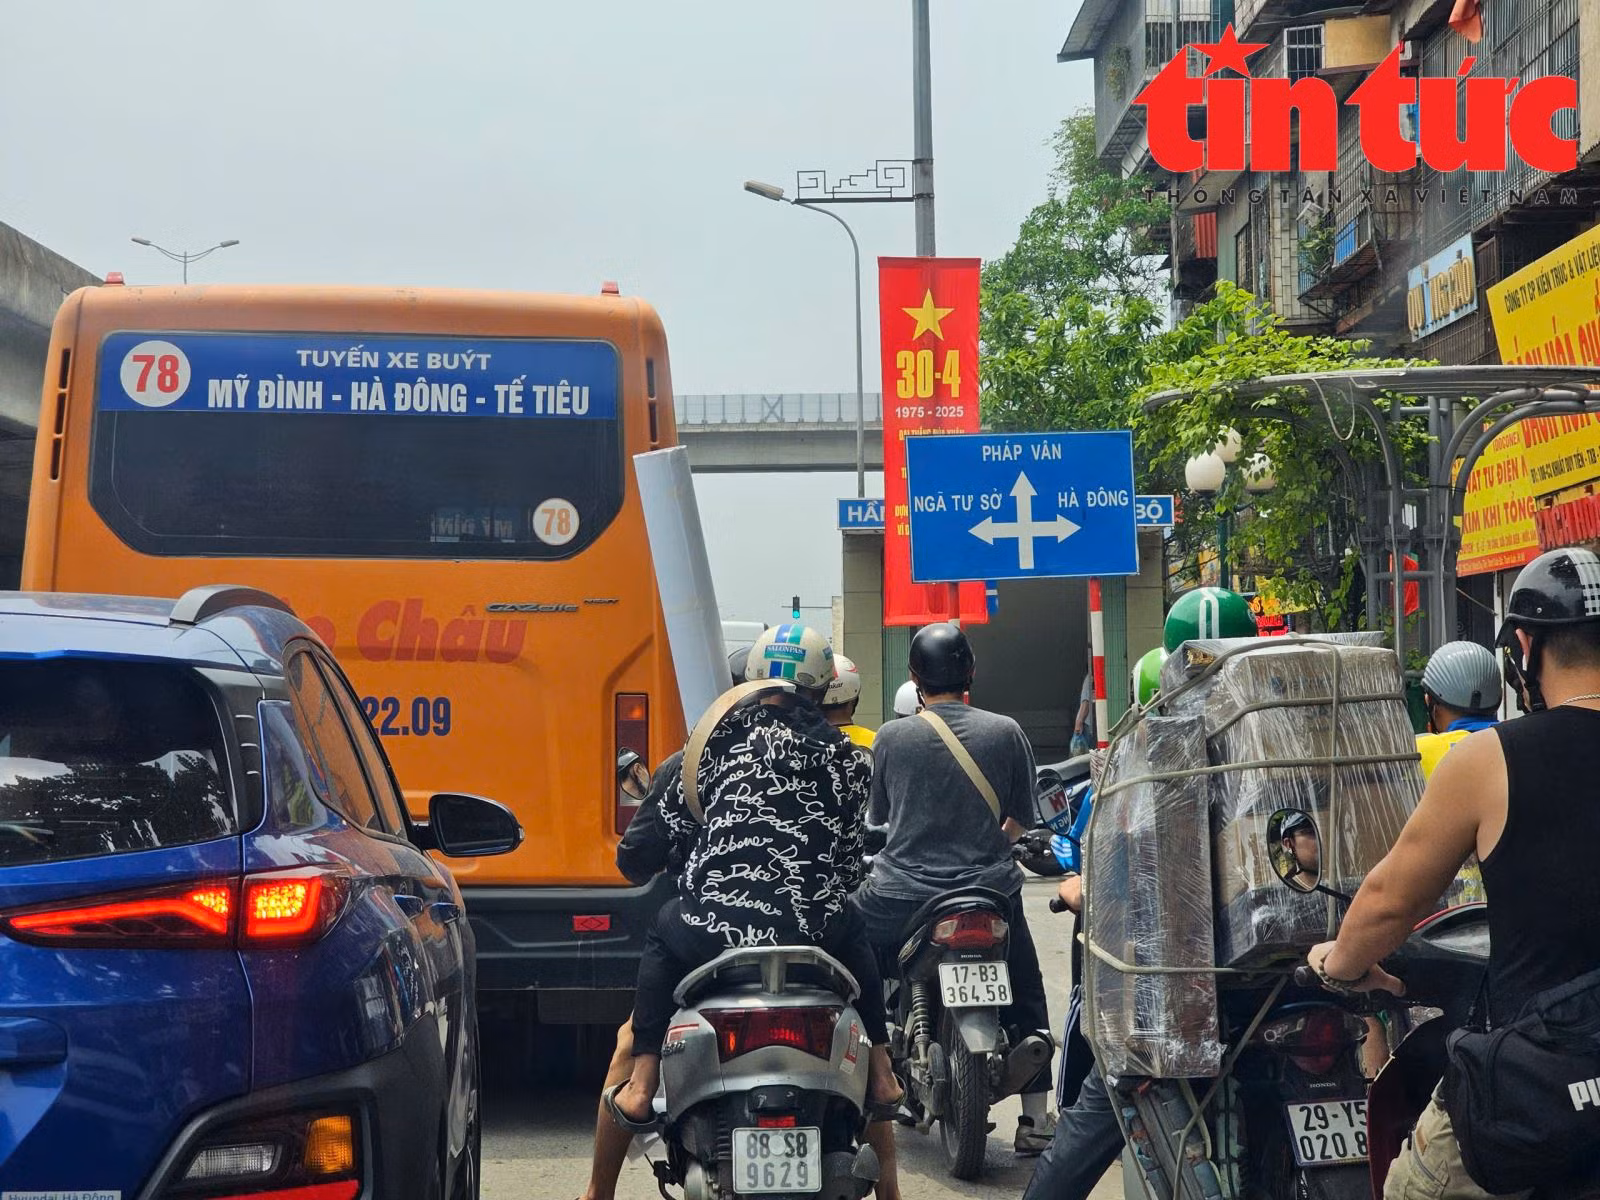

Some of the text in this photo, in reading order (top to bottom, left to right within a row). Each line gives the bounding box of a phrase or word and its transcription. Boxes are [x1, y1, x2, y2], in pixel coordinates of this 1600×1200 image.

[1520, 287, 1529, 306] TY
[1527, 280, 1536, 301] CP
[297, 344, 492, 371] TUYẾN XE BUÝT
[132, 354, 180, 393] 78
[896, 349, 961, 399] 30-4
[208, 373, 250, 408] MỸ
[258, 374, 323, 410] ĐÌNH
[351, 376, 386, 411] HÀ
[394, 376, 467, 413] ĐÔNG
[494, 375, 527, 414] TẾ
[532, 380, 590, 415] TIÊU
[895, 406, 924, 419] 1975
[935, 406, 964, 418] 2025
[982, 443, 1062, 461] PHÁP VÂN
[847, 499, 885, 522] HẦ
[914, 488, 1003, 512] NGÃ TƯ SỞ
[1058, 487, 1129, 508] HÀ ĐÔNG
[541, 508, 571, 536] 78
[1463, 510, 1481, 534] KIM
[357, 598, 528, 664] Châu
[359, 697, 451, 737] 22.09
[952, 965, 998, 983] 17-B3
[946, 984, 1007, 1003] 364.58
[1299, 1102, 1367, 1131] 29-Y5
[1299, 1131, 1369, 1161] 020.8
[746, 1162, 808, 1188] 9629
